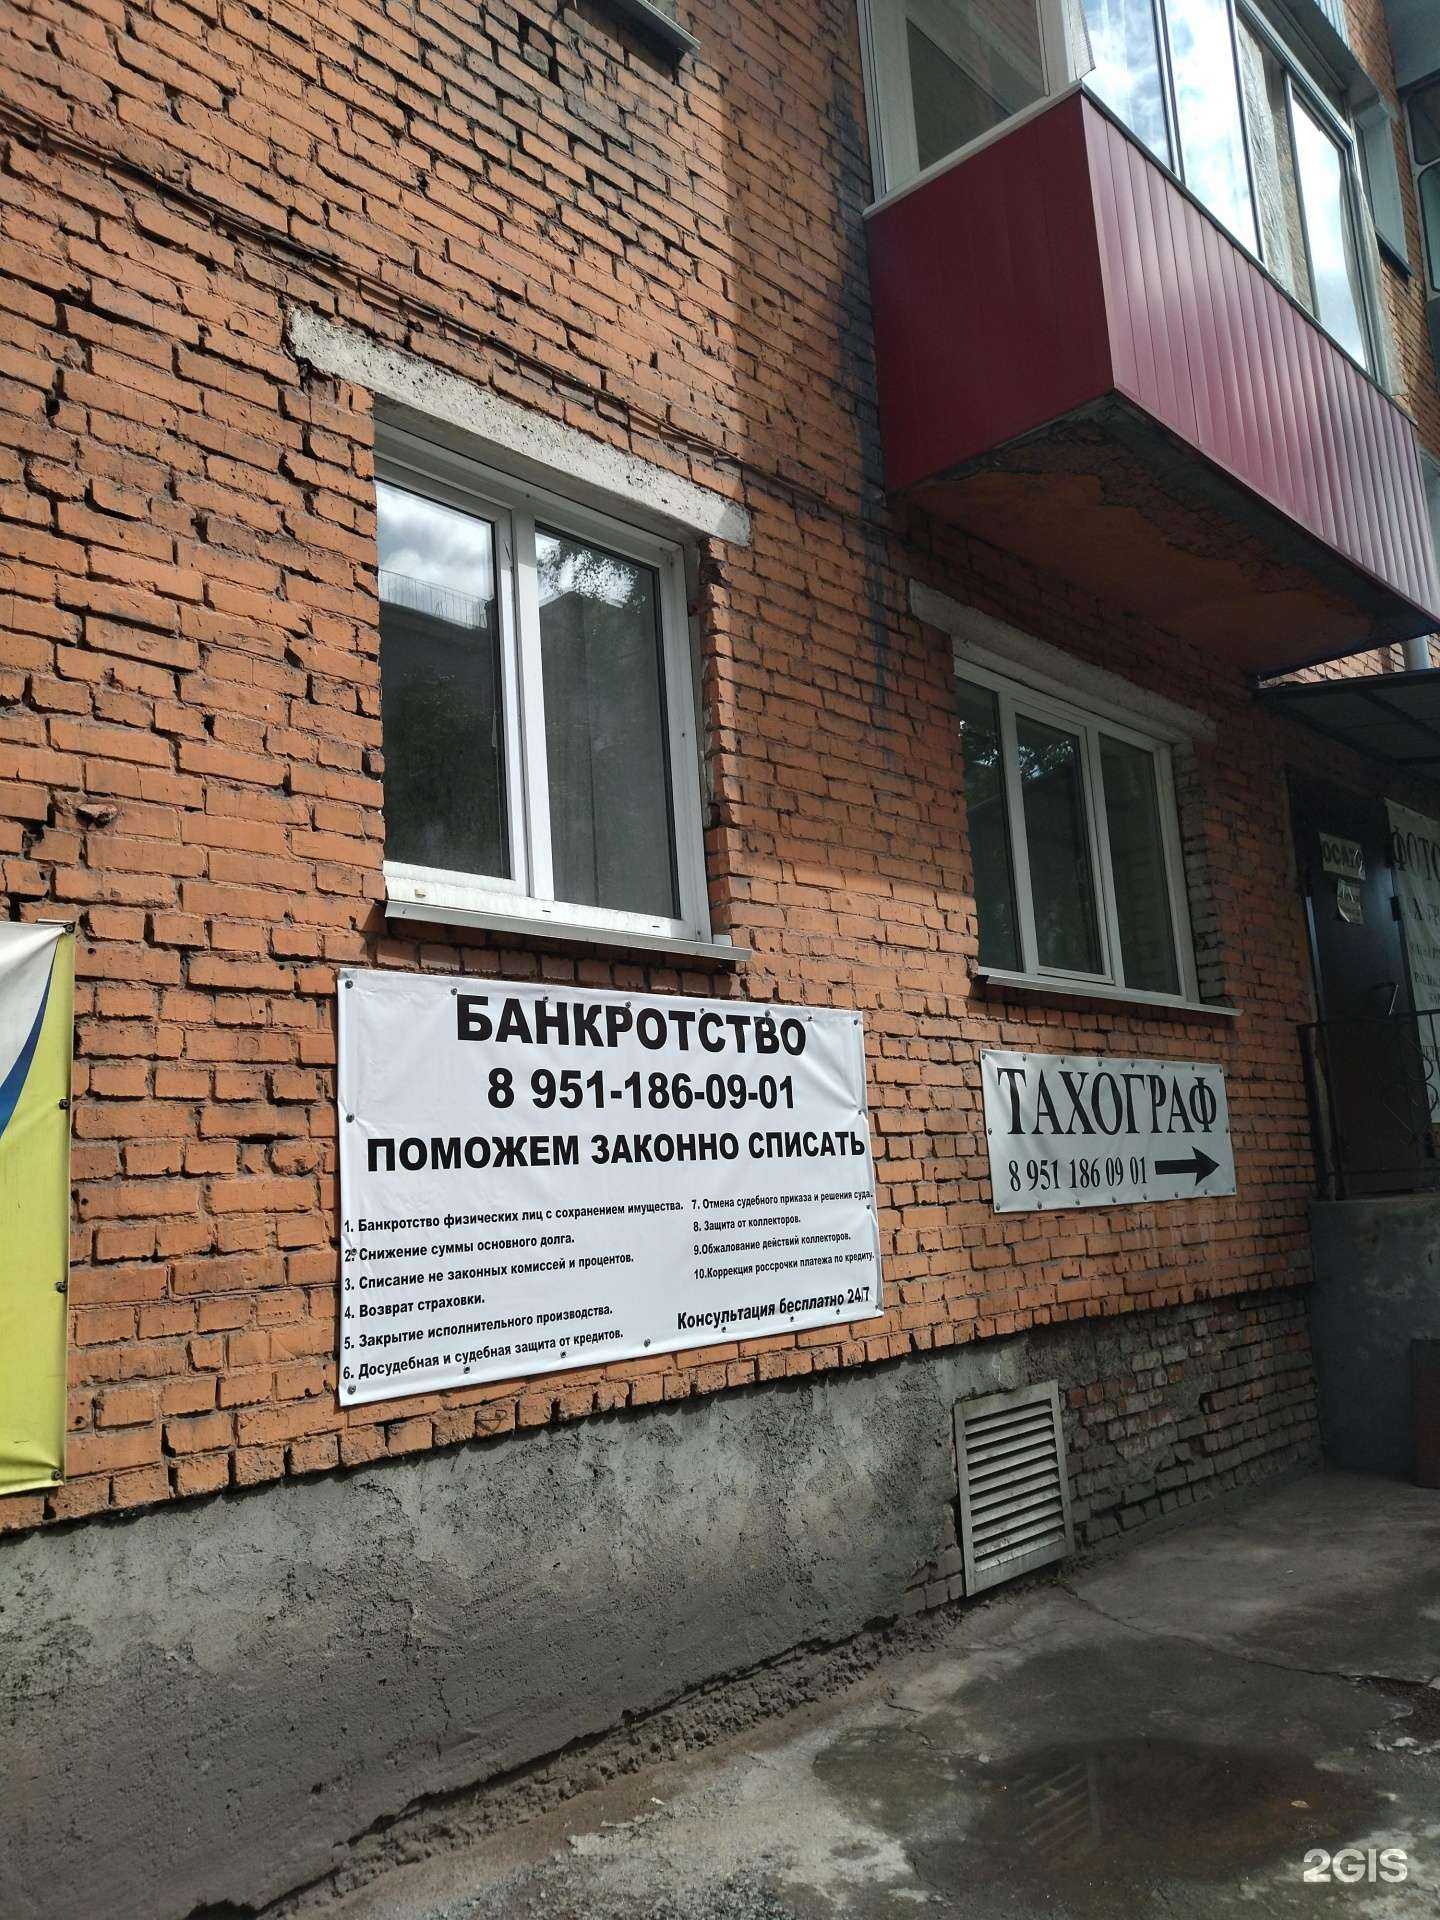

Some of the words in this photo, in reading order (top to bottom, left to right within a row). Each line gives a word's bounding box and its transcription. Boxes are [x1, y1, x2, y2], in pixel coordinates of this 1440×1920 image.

[457, 995, 806, 1055] БАНКРОТСТВО
[488, 1068, 513, 1108] 8
[532, 1068, 794, 1109] 951-186-09-01
[997, 1068, 1217, 1135] ТАХОГРАФ
[367, 1136, 578, 1172] ПОМОЖЕМ
[591, 1132, 739, 1165] ЗАКОННО
[750, 1131, 865, 1158] СПИСАТЬ
[1009, 1160, 1021, 1191] 8
[1027, 1159, 1060, 1191] 951
[1069, 1158, 1100, 1189] 186
[1106, 1157, 1123, 1186] 09
[1129, 1157, 1147, 1184] 01
[344, 1220, 354, 1232] 1.
[358, 1216, 440, 1231] Банкротство
[444, 1211, 518, 1229] физических
[522, 1209, 543, 1221] лиц
[546, 1210, 552, 1219] с
[555, 1204, 625, 1223] сохранением
[628, 1200, 684, 1215] имущества.
[692, 1199, 700, 1209] 7.
[703, 1198, 734, 1209] Отмена
[737, 1195, 778, 1208] судебного
[780, 1194, 812, 1205] приказа
[821, 1191, 852, 1203] решения
[854, 1190, 873, 1199] суда.
[693, 1222, 701, 1232] 8.
[704, 1217, 735, 1231] Защита
[738, 1217, 746, 1228] от
[749, 1215, 801, 1227] коллекторов.
[359, 1245, 427, 1261] Снижение
[431, 1242, 473, 1256] суммы
[477, 1236, 537, 1251] основного
[540, 1234, 575, 1247] долга.
[693, 1241, 760, 1255] 9.Обжалование
[762, 1236, 799, 1250] действий
[801, 1232, 851, 1245] коллекторов.
[345, 1278, 355, 1291] 3.
[359, 1274, 424, 1289] Списание
[428, 1271, 444, 1282] не
[447, 1264, 507, 1281] законных
[510, 1257, 566, 1274] комиссей
[569, 1259, 575, 1268] и
[579, 1253, 634, 1270] процентов.
[694, 1261, 753, 1279] 10.Коррекция
[755, 1259, 798, 1274] россрочки
[800, 1255, 832, 1267] платежа
[834, 1254, 843, 1263] по
[845, 1251, 875, 1263] кредиту.
[344, 1306, 355, 1319] 4.
[359, 1302, 414, 1317] Возврат
[418, 1294, 485, 1311] страховки.
[677, 1301, 775, 1329] Консультация
[779, 1292, 844, 1314] бесплатно
[848, 1287, 870, 1304] 24/7
[344, 1336, 354, 1349] 5.
[359, 1330, 424, 1347] Закрытие
[428, 1314, 533, 1338] исполнительного
[536, 1305, 613, 1326] производства.
[343, 1367, 354, 1380] 6.
[358, 1353, 439, 1380] Досудебная
[443, 1354, 451, 1365] и
[455, 1345, 511, 1364] судебная
[515, 1337, 556, 1354] защита
[559, 1336, 570, 1347] от
[573, 1328, 624, 1347] кредитов.
